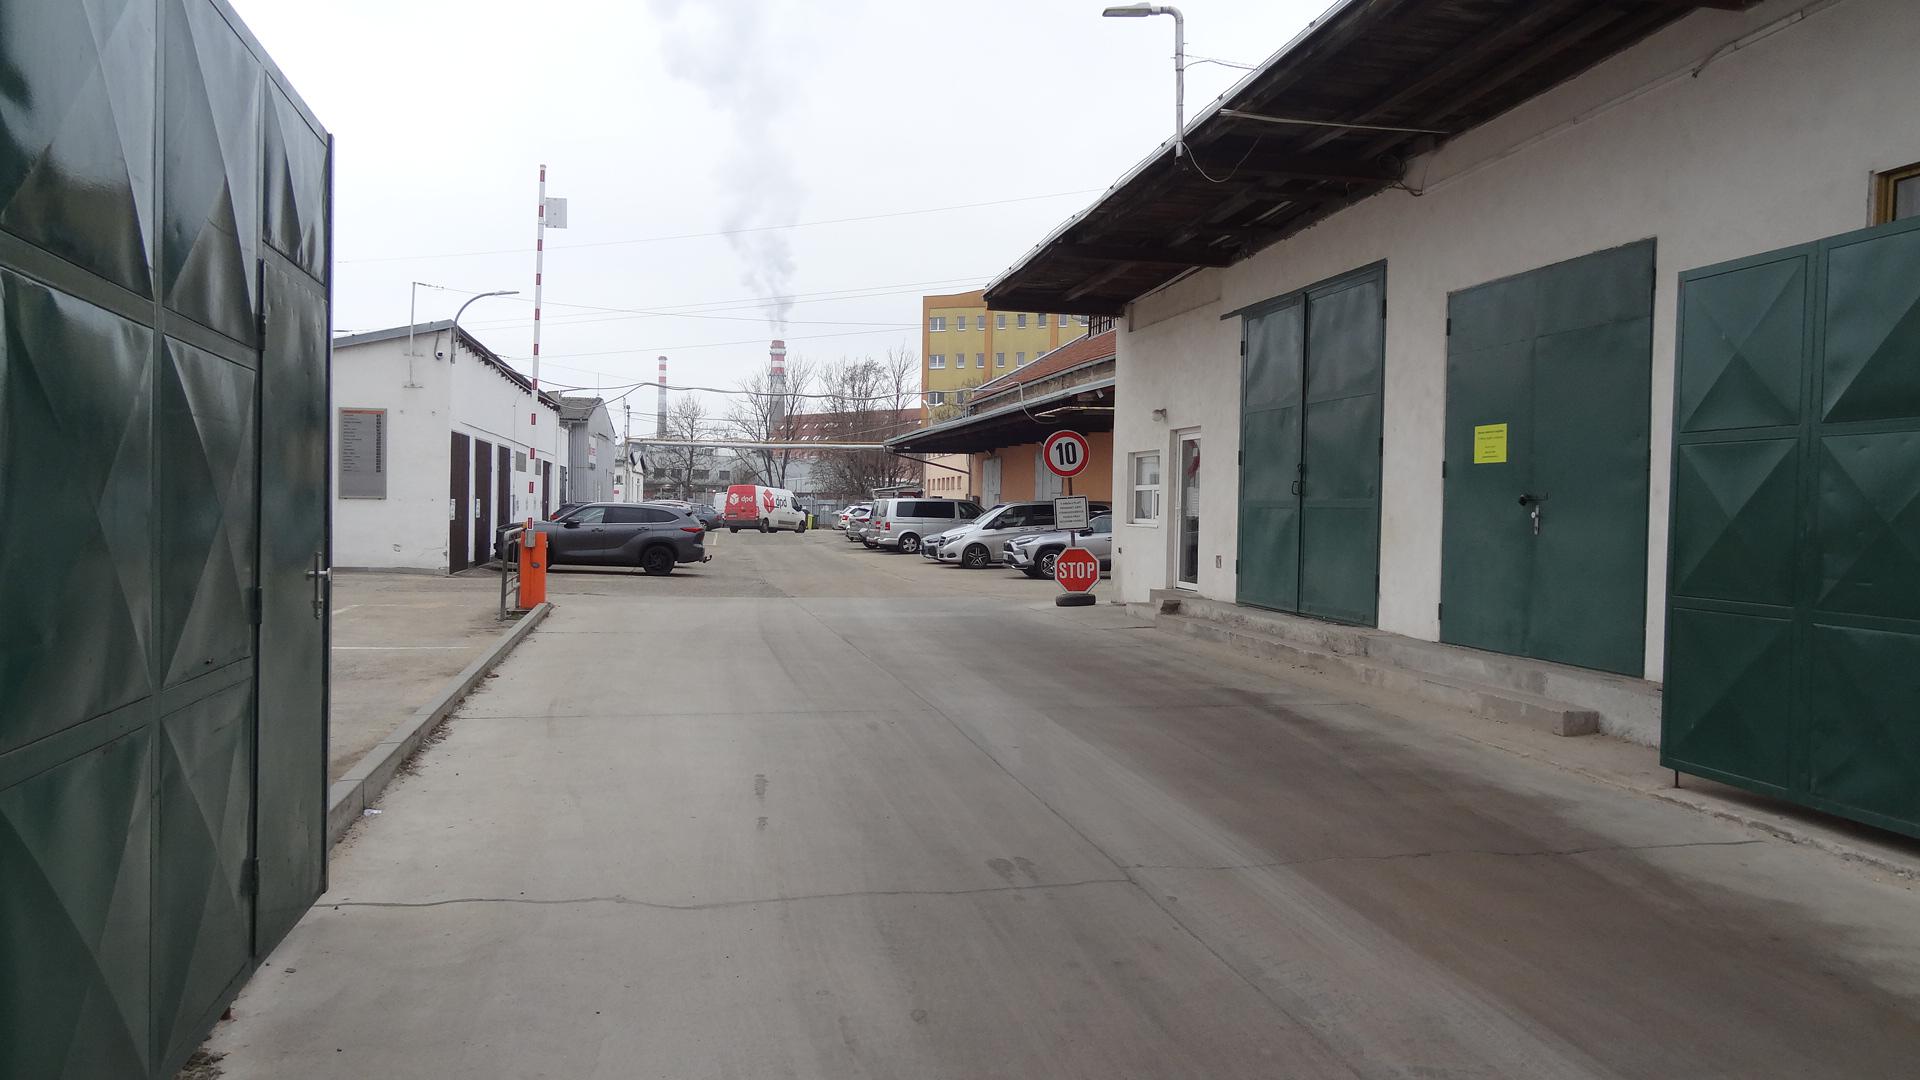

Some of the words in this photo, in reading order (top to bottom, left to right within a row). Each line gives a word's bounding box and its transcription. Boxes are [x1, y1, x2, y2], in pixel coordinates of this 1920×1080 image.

[1055, 441, 1077, 465] 10
[741, 495, 753, 503] dpd
[776, 495, 787, 509] dpd
[1058, 561, 1095, 579] STOP
